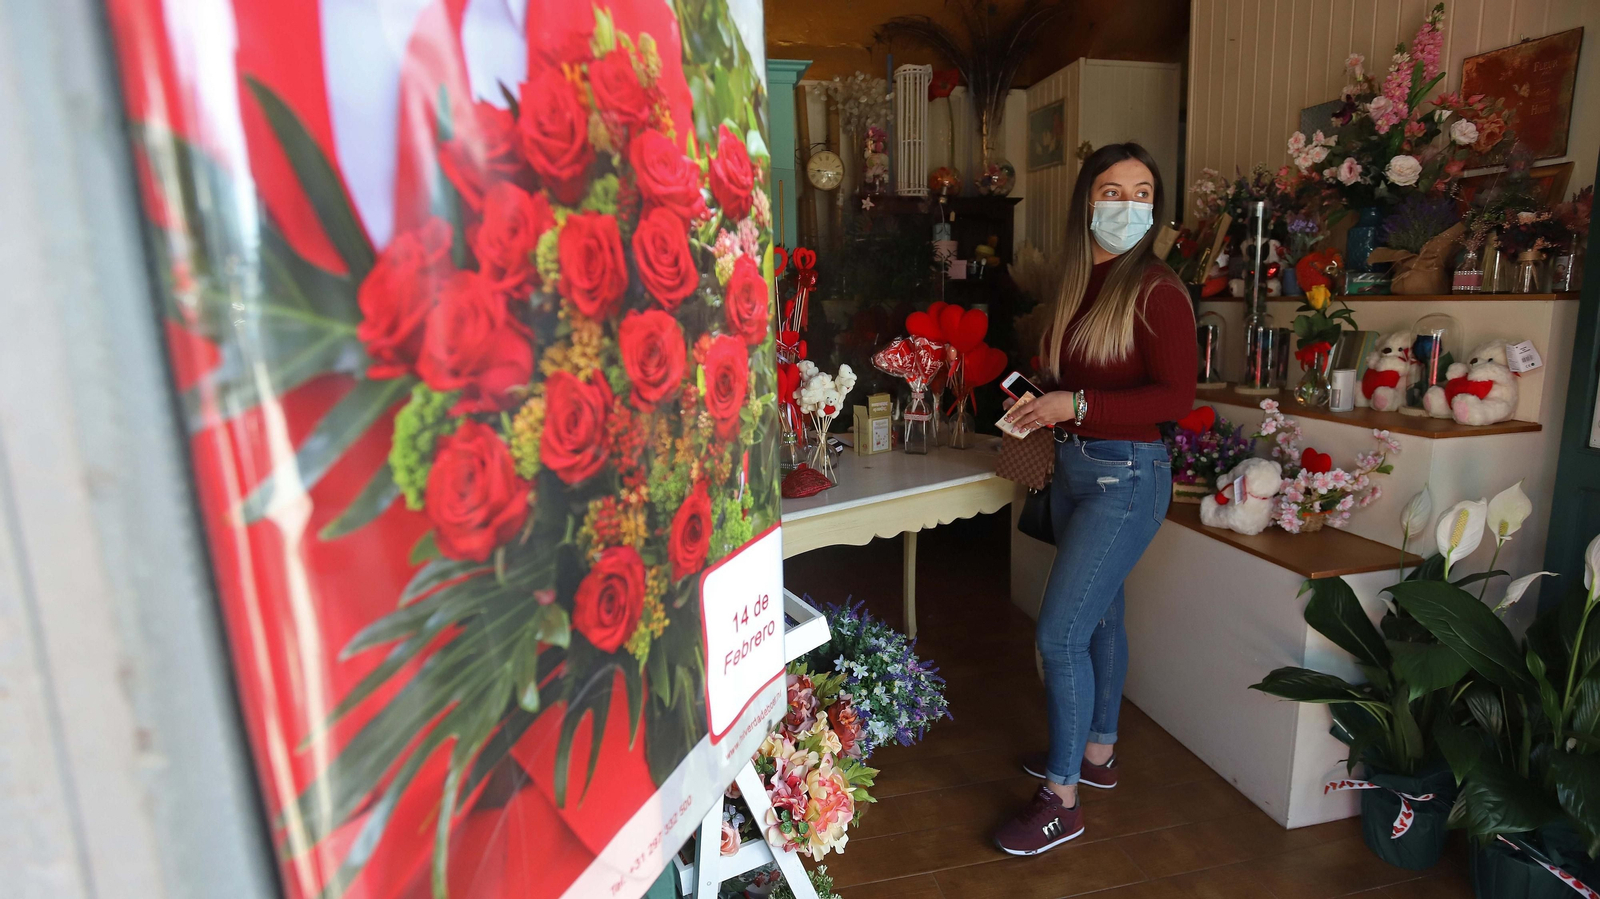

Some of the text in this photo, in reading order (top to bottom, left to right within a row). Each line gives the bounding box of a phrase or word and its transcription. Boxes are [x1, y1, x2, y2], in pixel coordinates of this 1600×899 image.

[733, 594, 769, 633] 14 de
[724, 620, 775, 676] Febrero
[679, 795, 693, 816] 500
